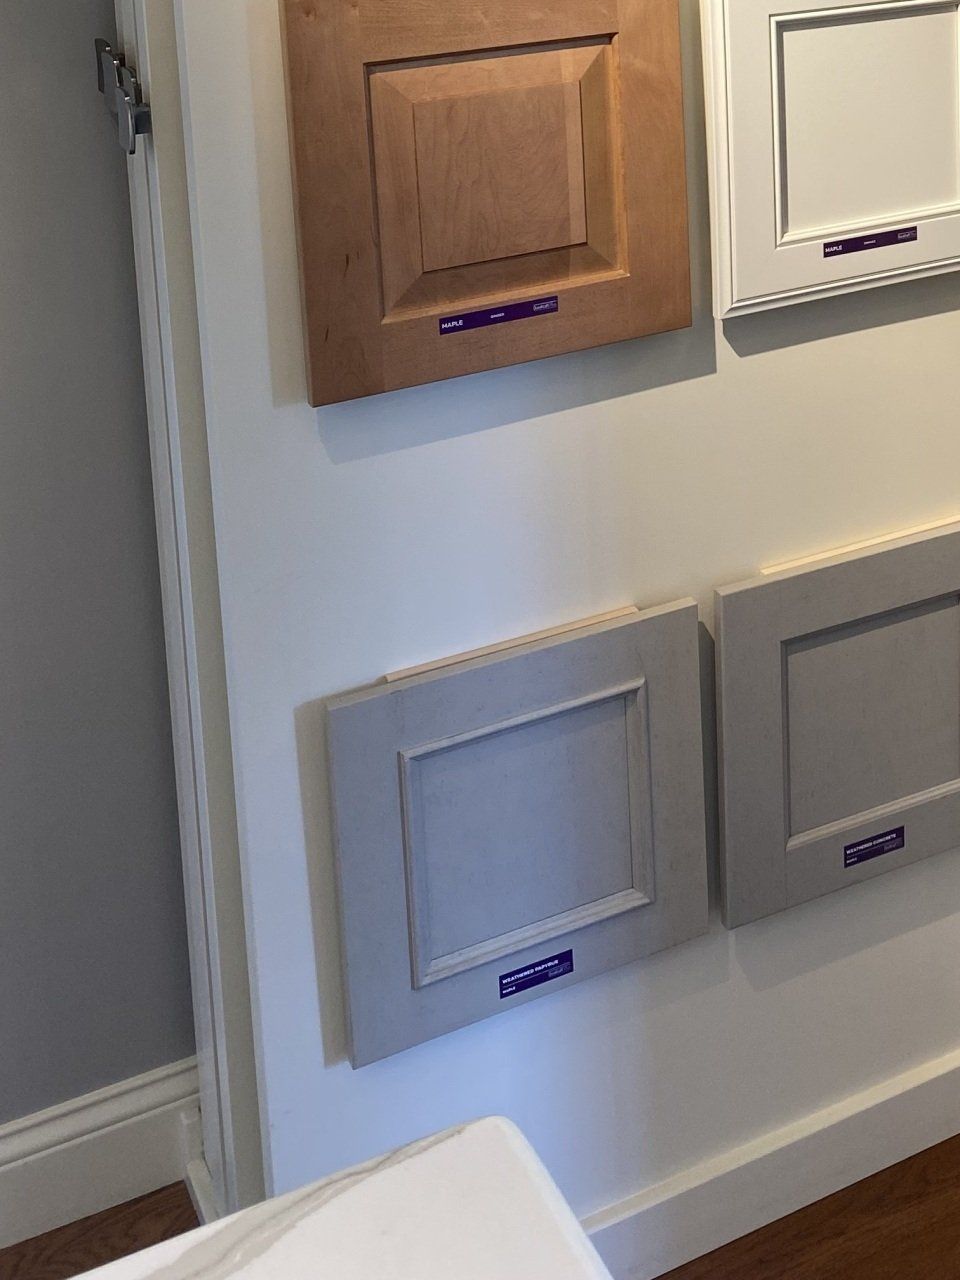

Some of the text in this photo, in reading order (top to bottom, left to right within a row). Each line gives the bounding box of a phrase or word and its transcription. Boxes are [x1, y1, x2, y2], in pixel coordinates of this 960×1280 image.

[825, 244, 842, 253] MAPLE
[441, 319, 464, 329] MAPLE
[502, 968, 535, 984] WEATHERED
